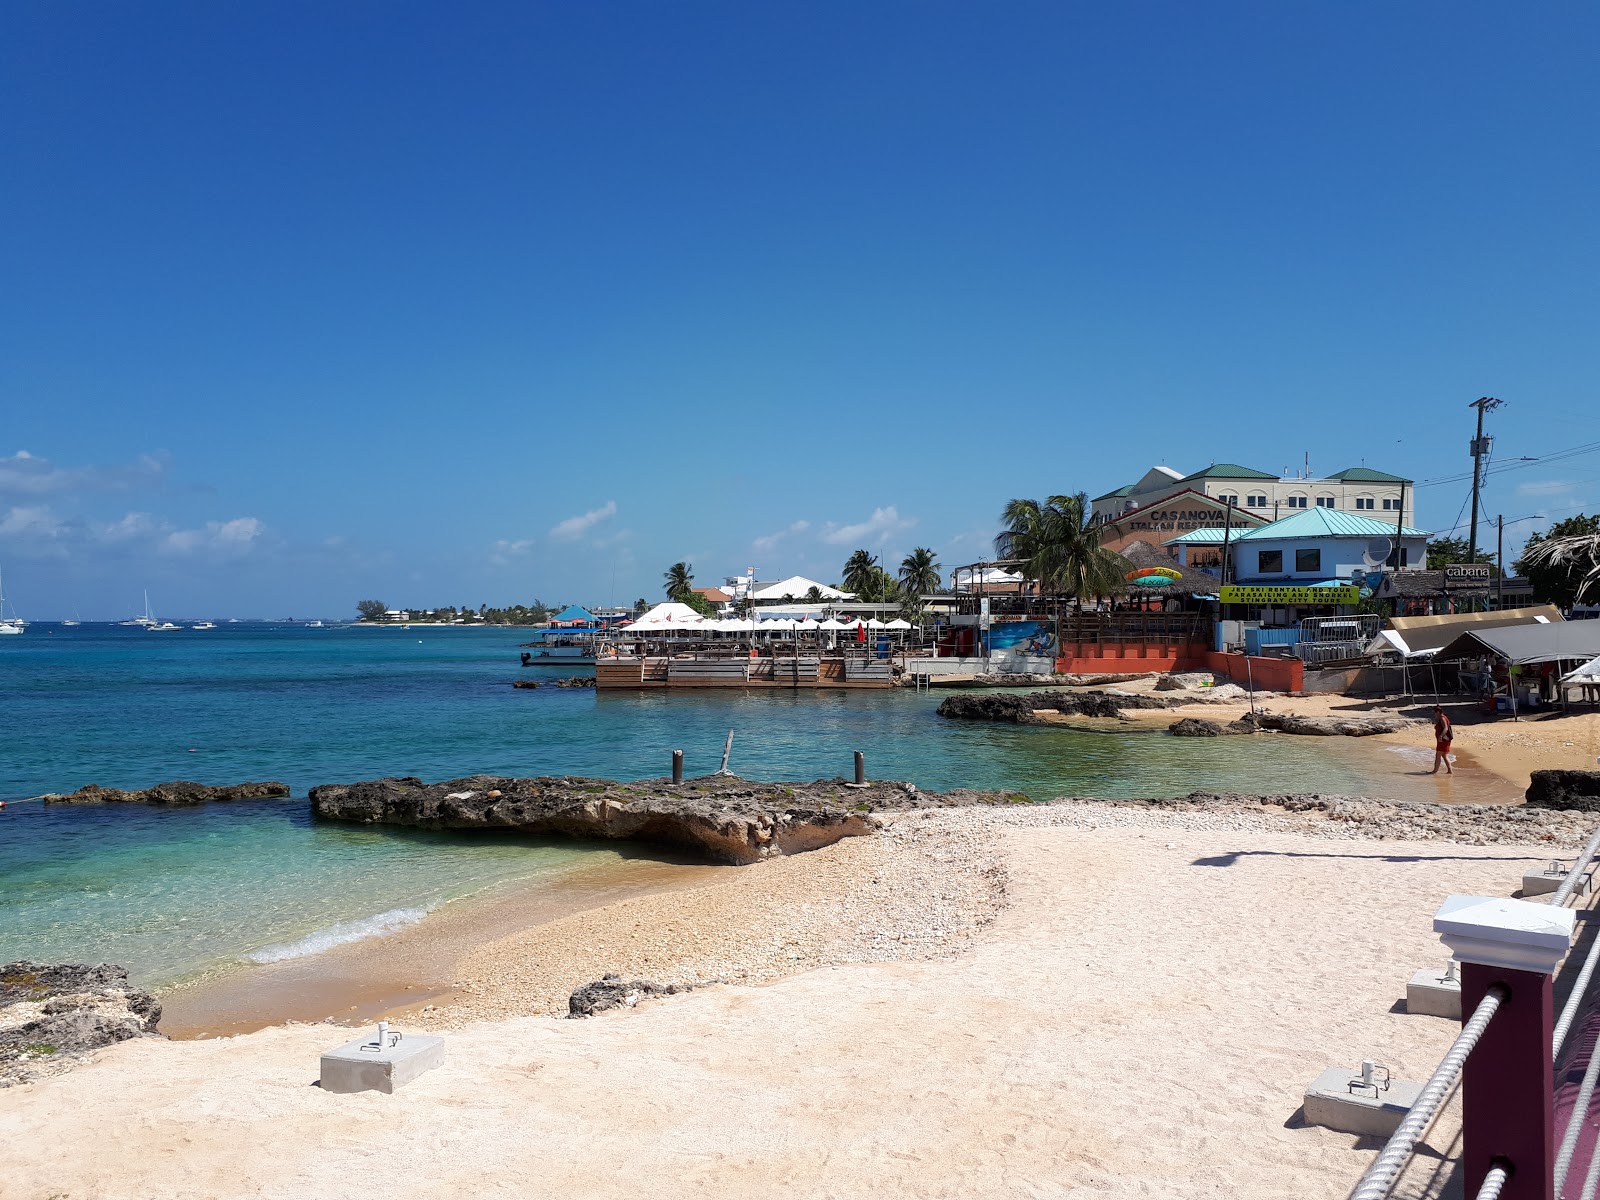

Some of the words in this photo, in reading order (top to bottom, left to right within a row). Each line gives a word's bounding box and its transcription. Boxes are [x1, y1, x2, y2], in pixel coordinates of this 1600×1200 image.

[1151, 511, 1224, 520] CASANOVA
[1130, 522, 1175, 530] ITALIAN
[1447, 566, 1489, 576] cabana
